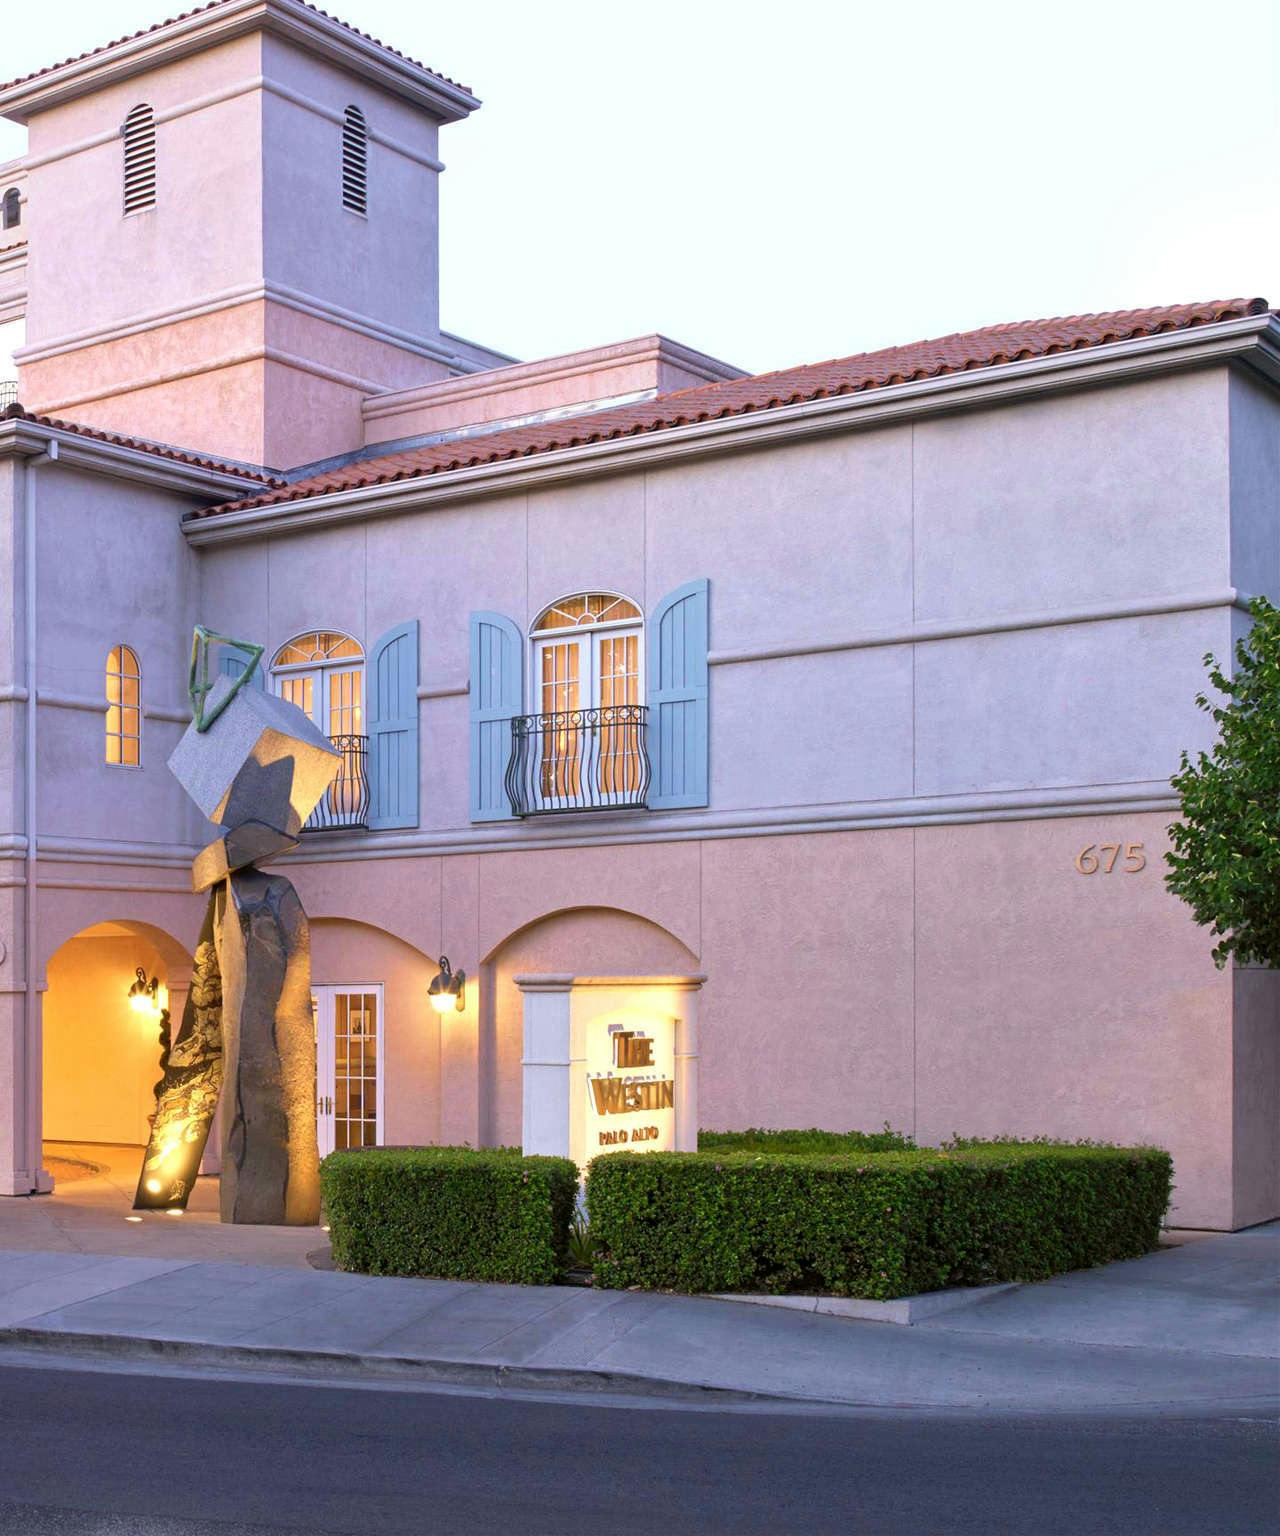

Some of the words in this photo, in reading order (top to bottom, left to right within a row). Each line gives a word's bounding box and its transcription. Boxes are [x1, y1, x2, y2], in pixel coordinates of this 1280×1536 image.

[1075, 843, 1146, 875] 675
[612, 1031, 656, 1069] THE
[590, 1077, 674, 1116] WESTIN
[599, 1128, 628, 1146] PALO
[631, 1126, 660, 1143] ALTO
